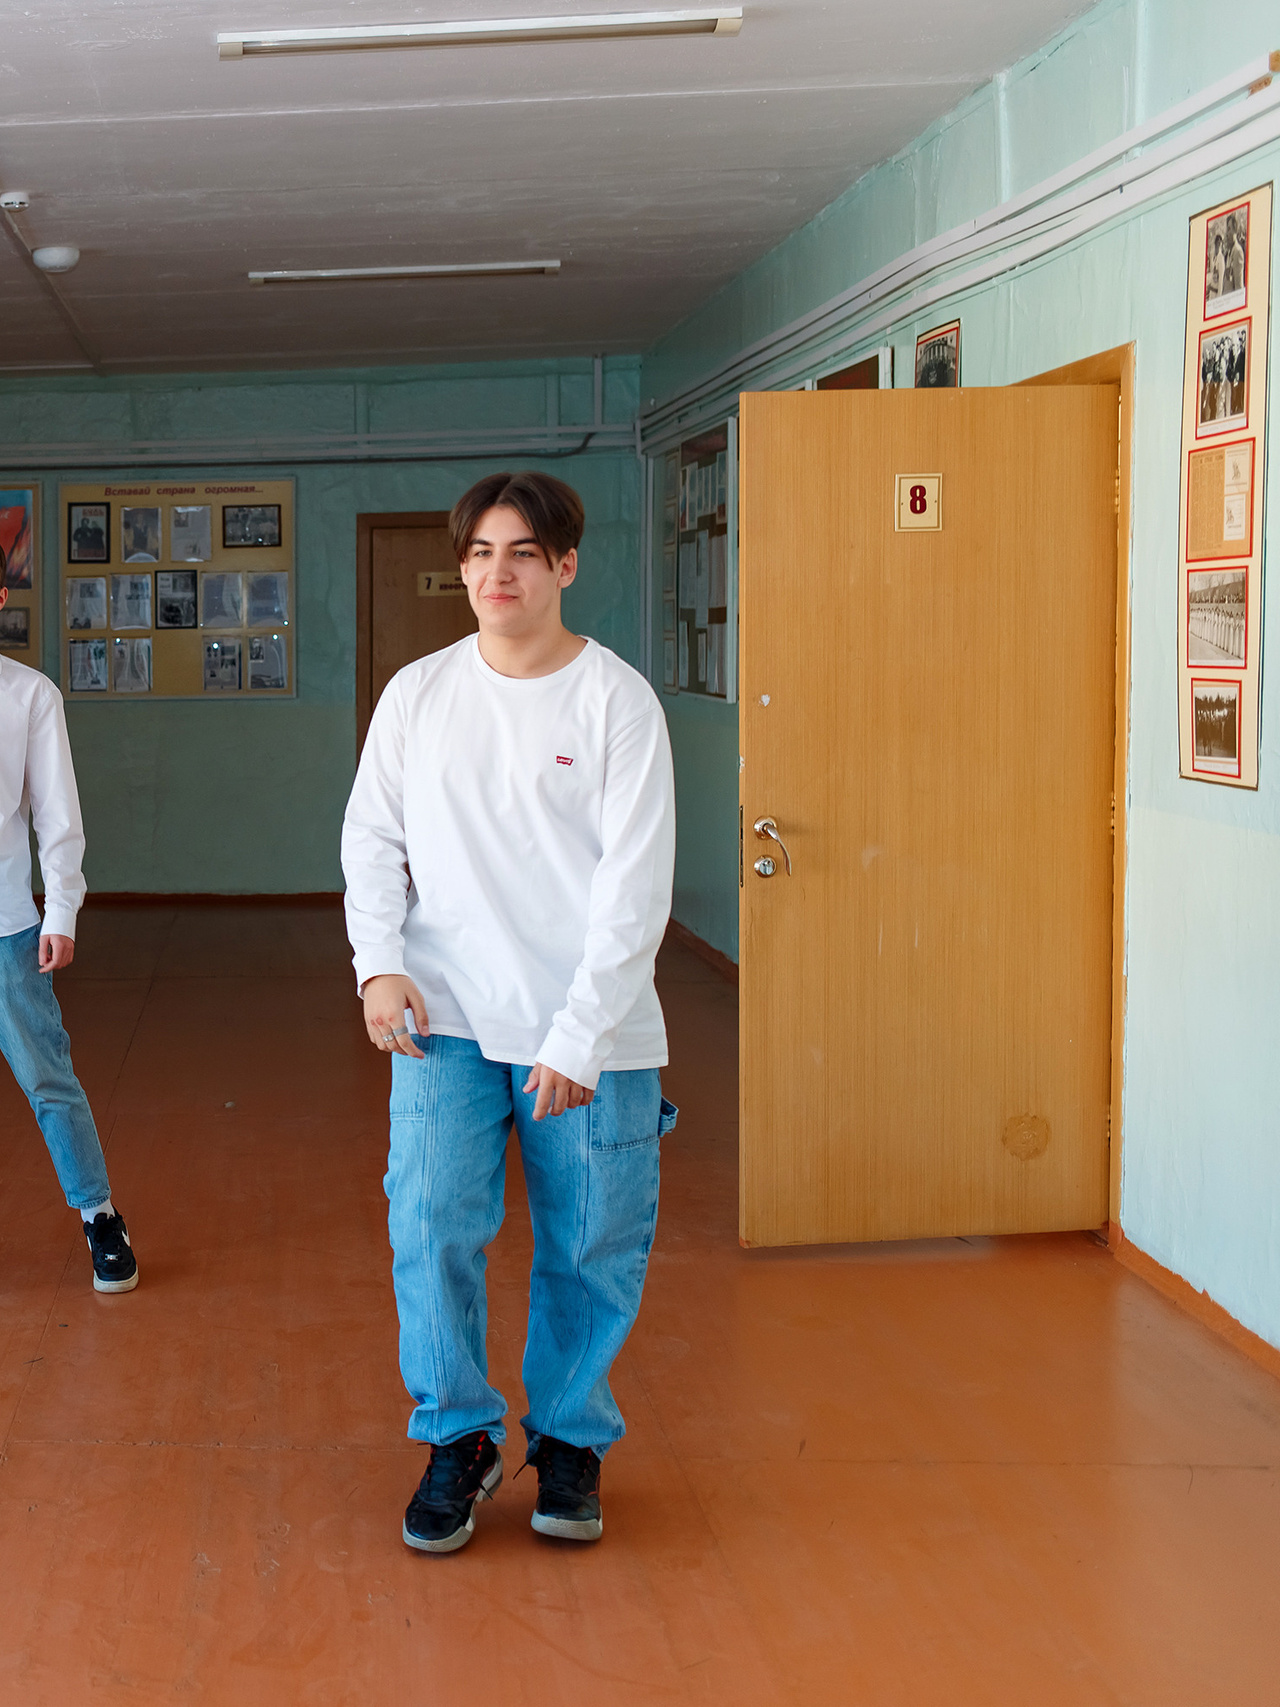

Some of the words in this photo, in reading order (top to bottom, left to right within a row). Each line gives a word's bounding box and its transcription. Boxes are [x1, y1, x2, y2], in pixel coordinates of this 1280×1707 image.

[104, 486, 151, 496] Вставай
[156, 487, 196, 497] страна
[910, 485, 927, 515] 8
[425, 577, 432, 590] 7
